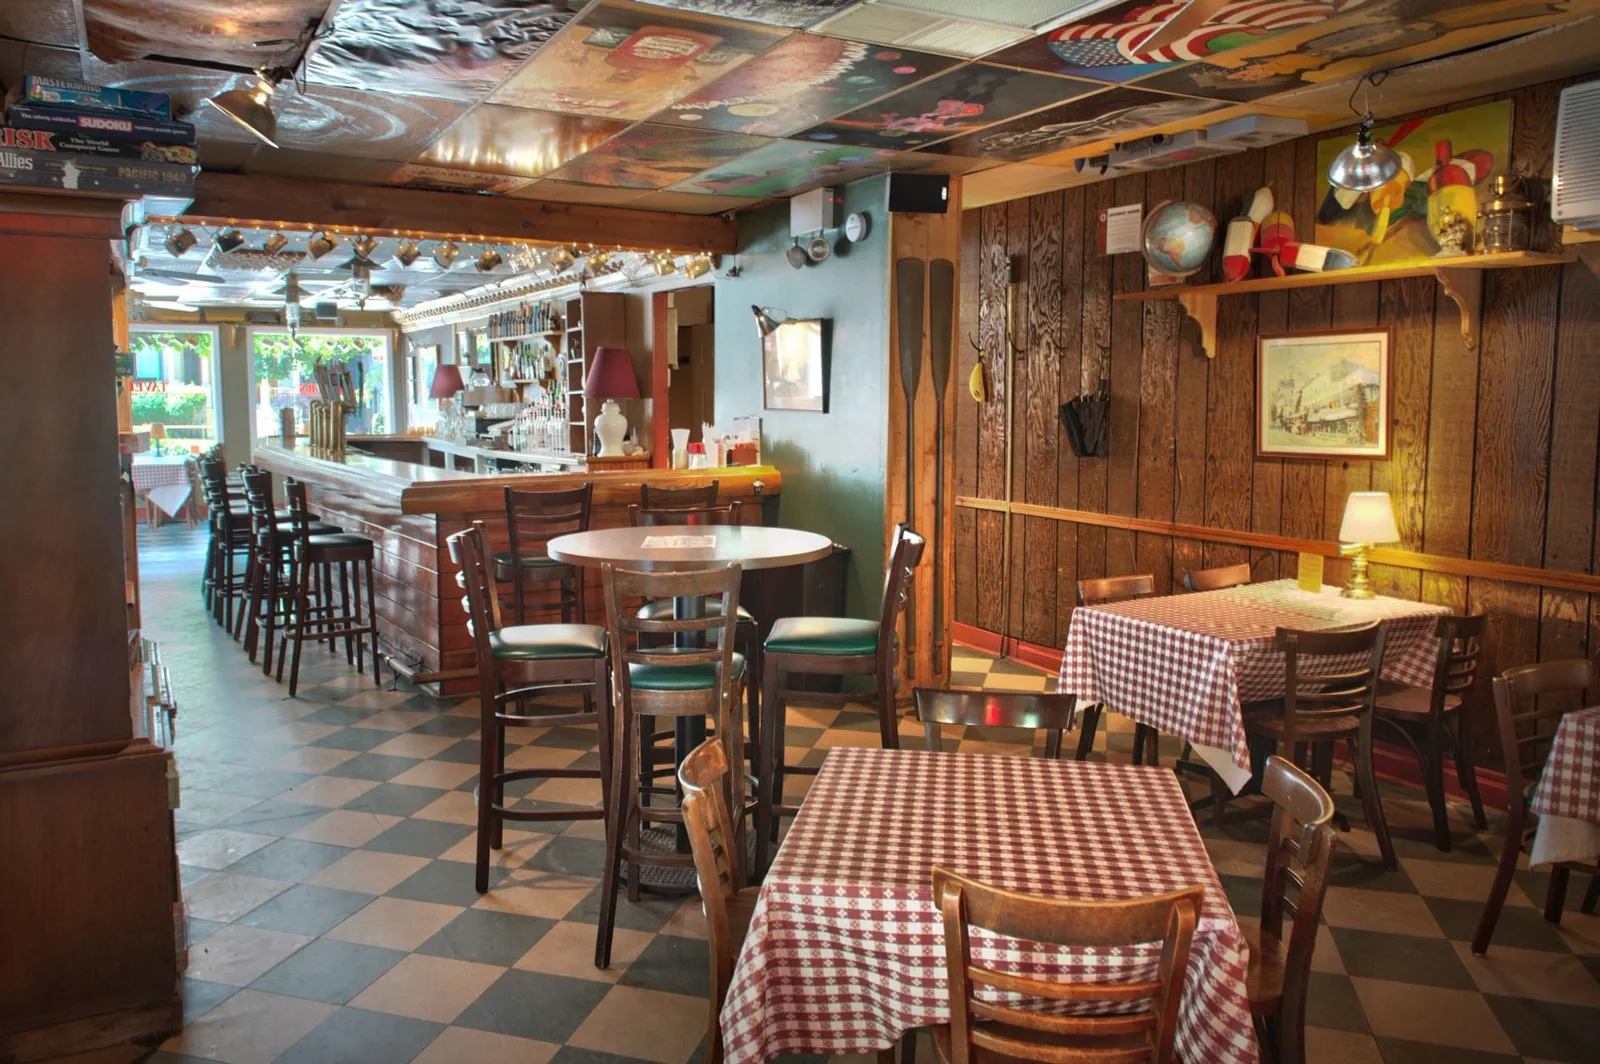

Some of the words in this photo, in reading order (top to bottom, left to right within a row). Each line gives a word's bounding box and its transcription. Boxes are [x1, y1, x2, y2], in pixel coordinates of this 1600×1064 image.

[32, 76, 101, 93] MASTERMIND
[80, 117, 133, 132] SUDOKU
[59, 142, 96, 151] Conquest
[97, 145, 120, 153] Game
[87, 139, 109, 147] World
[118, 167, 159, 180] PACIFIC
